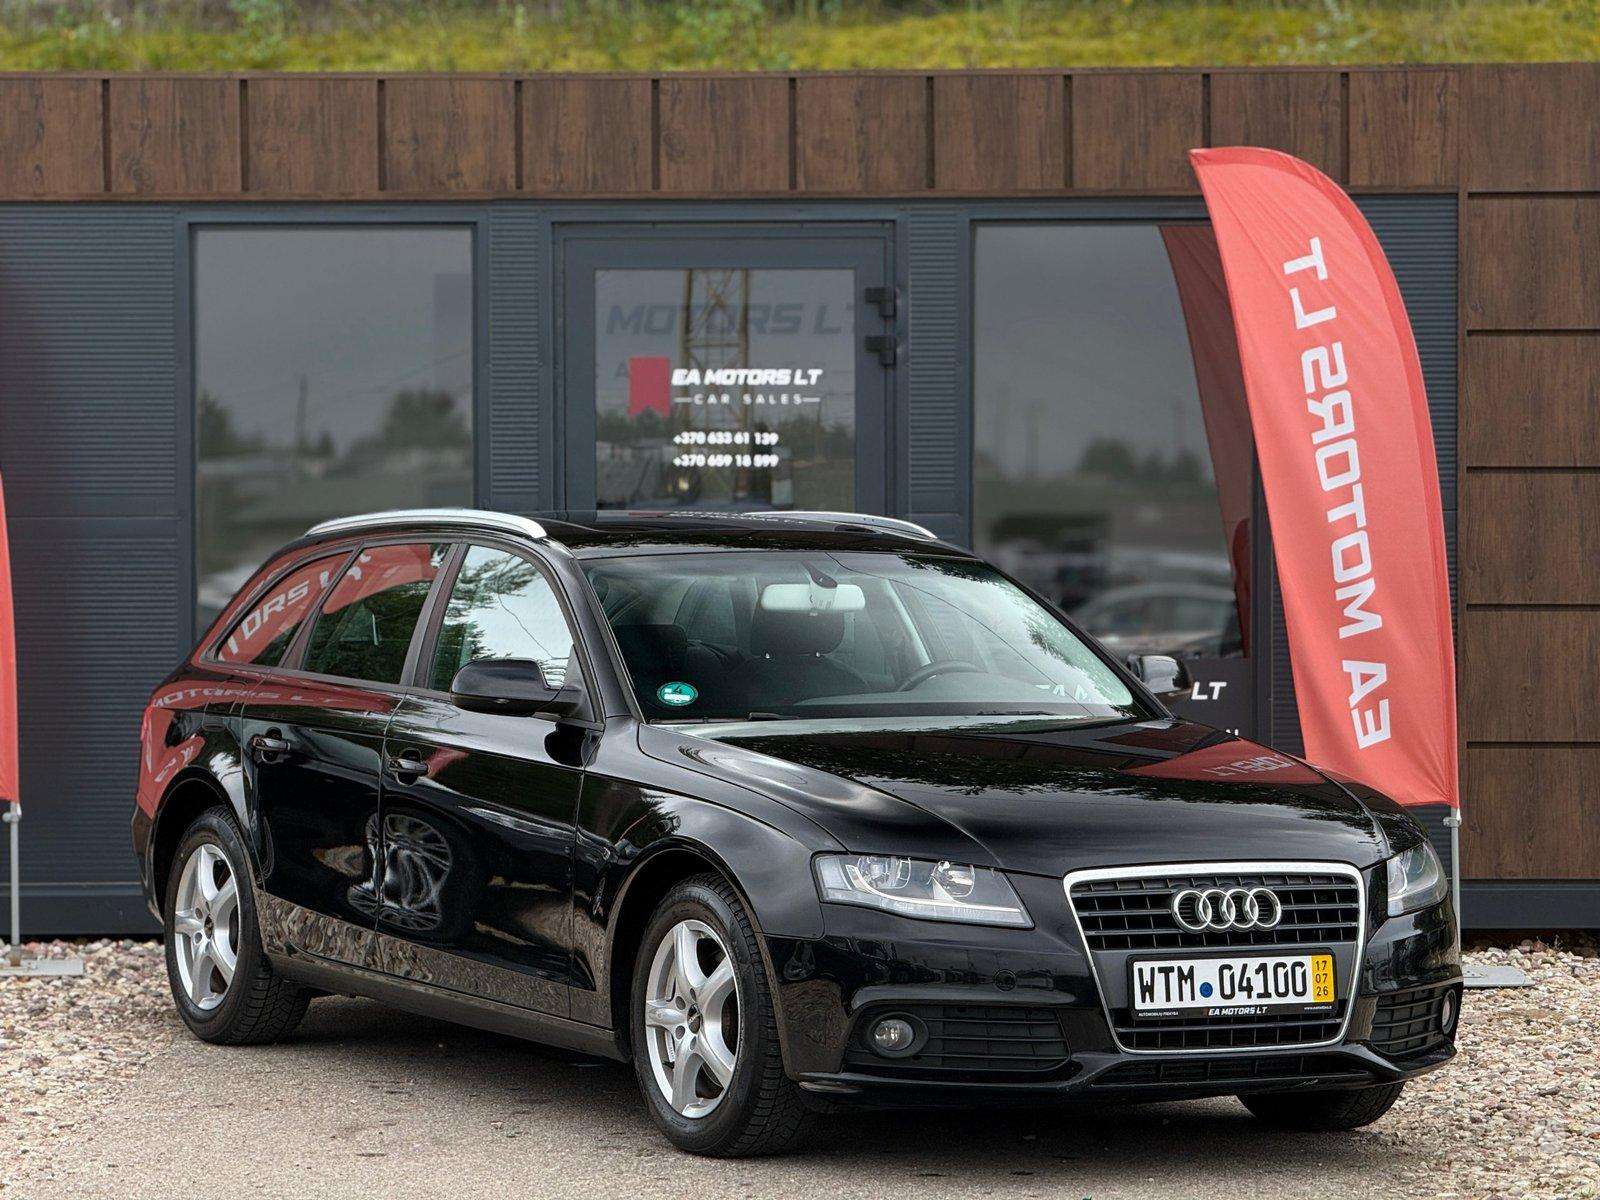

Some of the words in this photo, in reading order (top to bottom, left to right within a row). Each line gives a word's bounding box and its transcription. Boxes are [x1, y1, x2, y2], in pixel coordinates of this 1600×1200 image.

[671, 368, 701, 386] EA
[704, 368, 792, 386] MOTORS
[793, 368, 823, 386] LT
[693, 393, 731, 405] CAR
[742, 393, 803, 405] SALES
[673, 431, 706, 445] +370
[673, 454, 706, 467] +370
[1190, 681, 1228, 701] LT
[1315, 960, 1328, 971] 17
[1137, 965, 1196, 1004] WTM
[1218, 961, 1308, 1001] 04100
[1315, 973, 1328, 984] 07
[1316, 986, 1329, 997] 26
[1208, 1008, 1220, 1016] EA
[1221, 1007, 1255, 1016] MOTORS
[1255, 1006, 1268, 1015] LT
